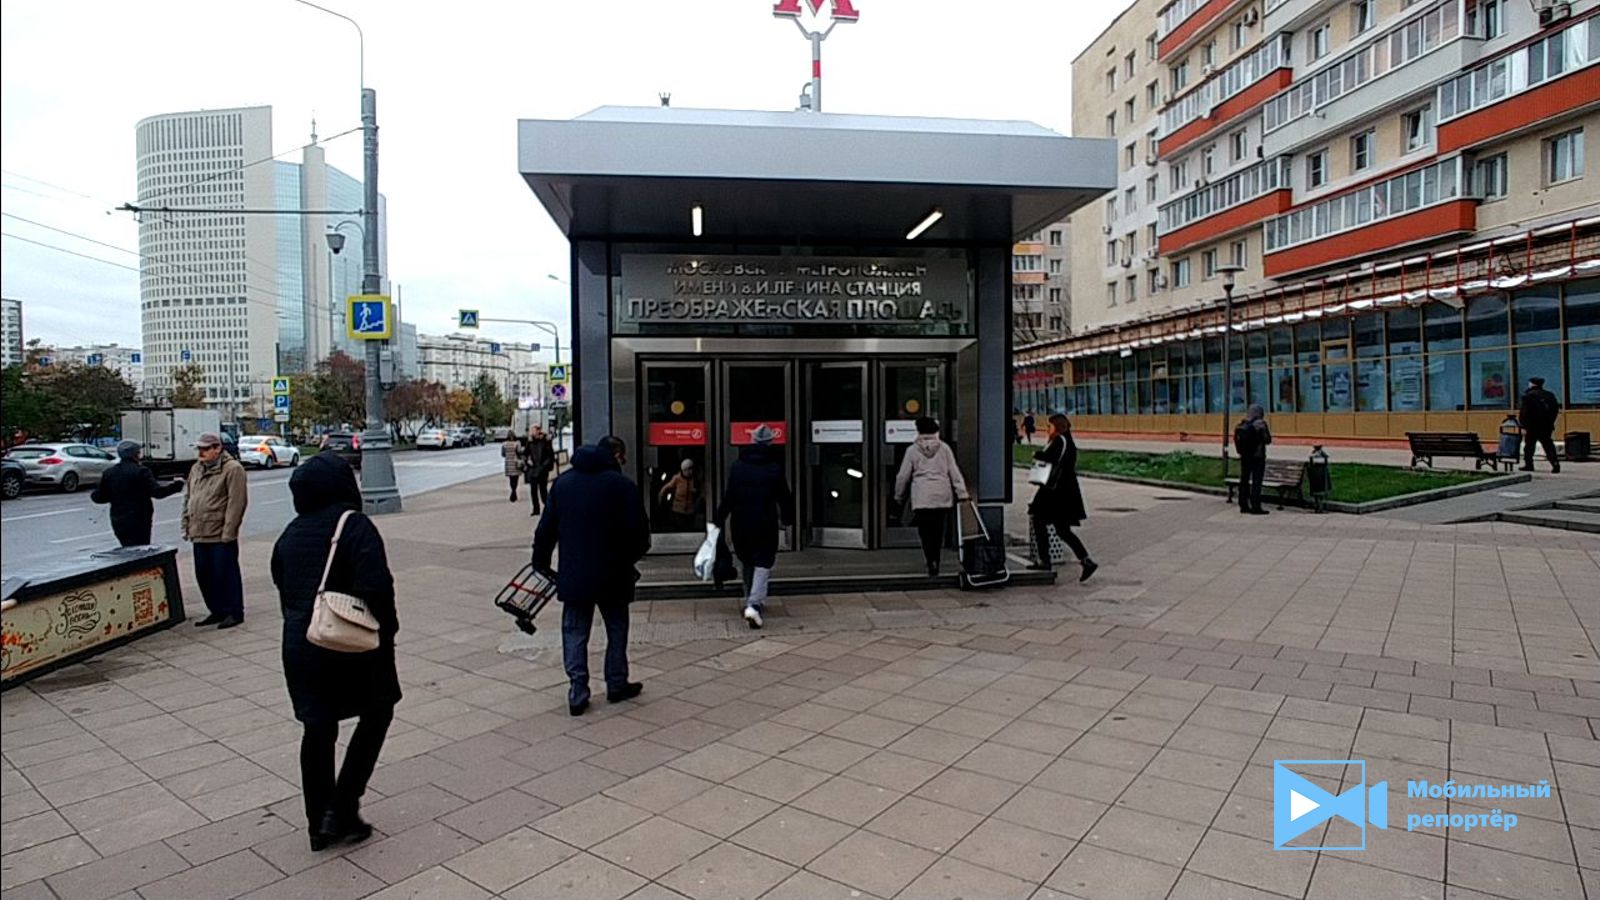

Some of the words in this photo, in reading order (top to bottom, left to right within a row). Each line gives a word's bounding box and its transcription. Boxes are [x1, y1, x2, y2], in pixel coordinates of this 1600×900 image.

[673, 279, 737, 295] ИМЕНИ
[846, 281, 922, 298] СТАНЦИЯ
[627, 298, 842, 319] ПРЕОБРАЖЕНСКАЯ
